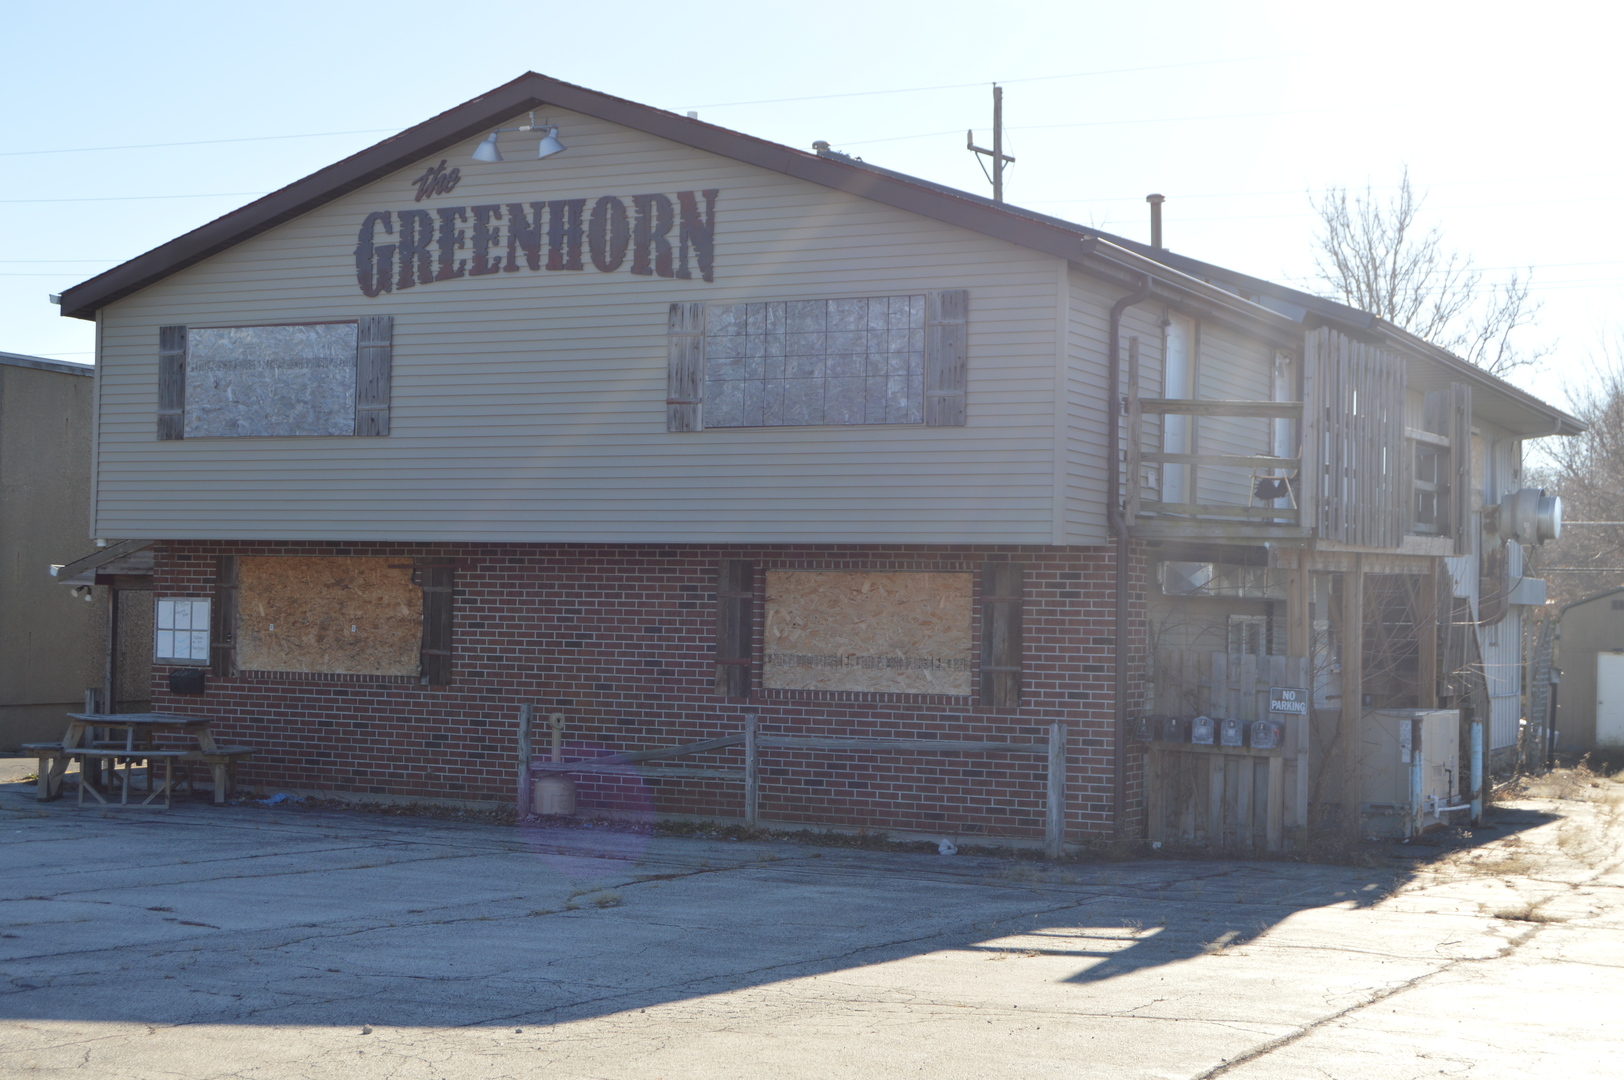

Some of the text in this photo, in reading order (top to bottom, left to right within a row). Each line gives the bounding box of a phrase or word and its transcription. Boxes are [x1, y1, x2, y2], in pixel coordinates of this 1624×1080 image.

[412, 159, 461, 202] the
[354, 189, 719, 298] GREENHORN
[1271, 700, 1306, 712] PARKING
[1282, 690, 1296, 701] NO
